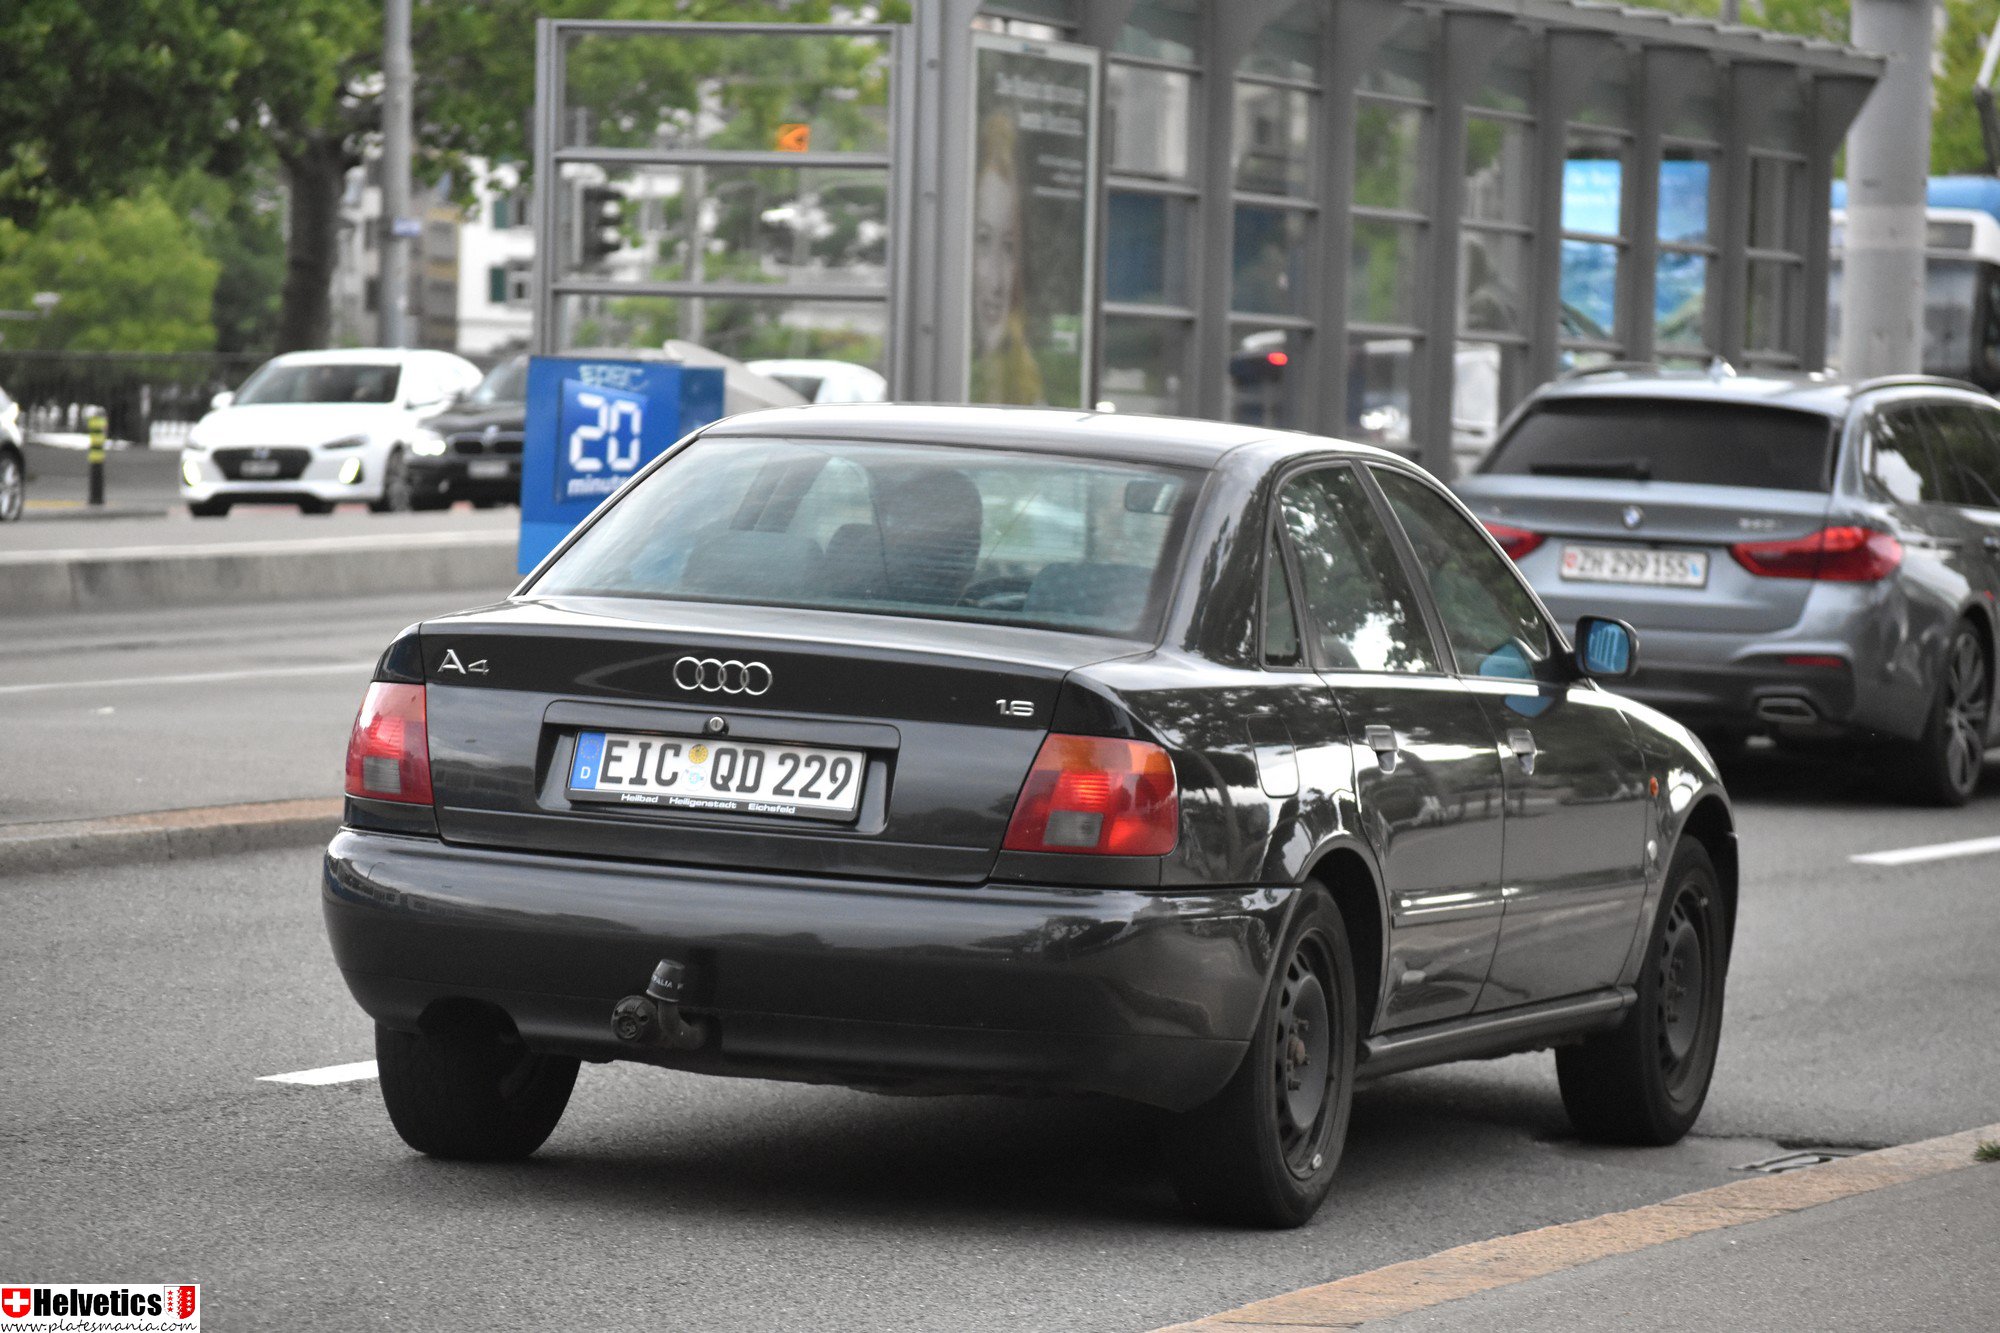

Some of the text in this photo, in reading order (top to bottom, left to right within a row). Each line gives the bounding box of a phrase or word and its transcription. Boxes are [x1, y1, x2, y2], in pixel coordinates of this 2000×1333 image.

[569, 392, 642, 473] 20
[437, 648, 490, 675] A4
[580, 766, 591, 779] D
[599, 740, 853, 801] EIC QD 229
[620, 793, 796, 815] Heilbad Heiligenstadt Eichsfeld
